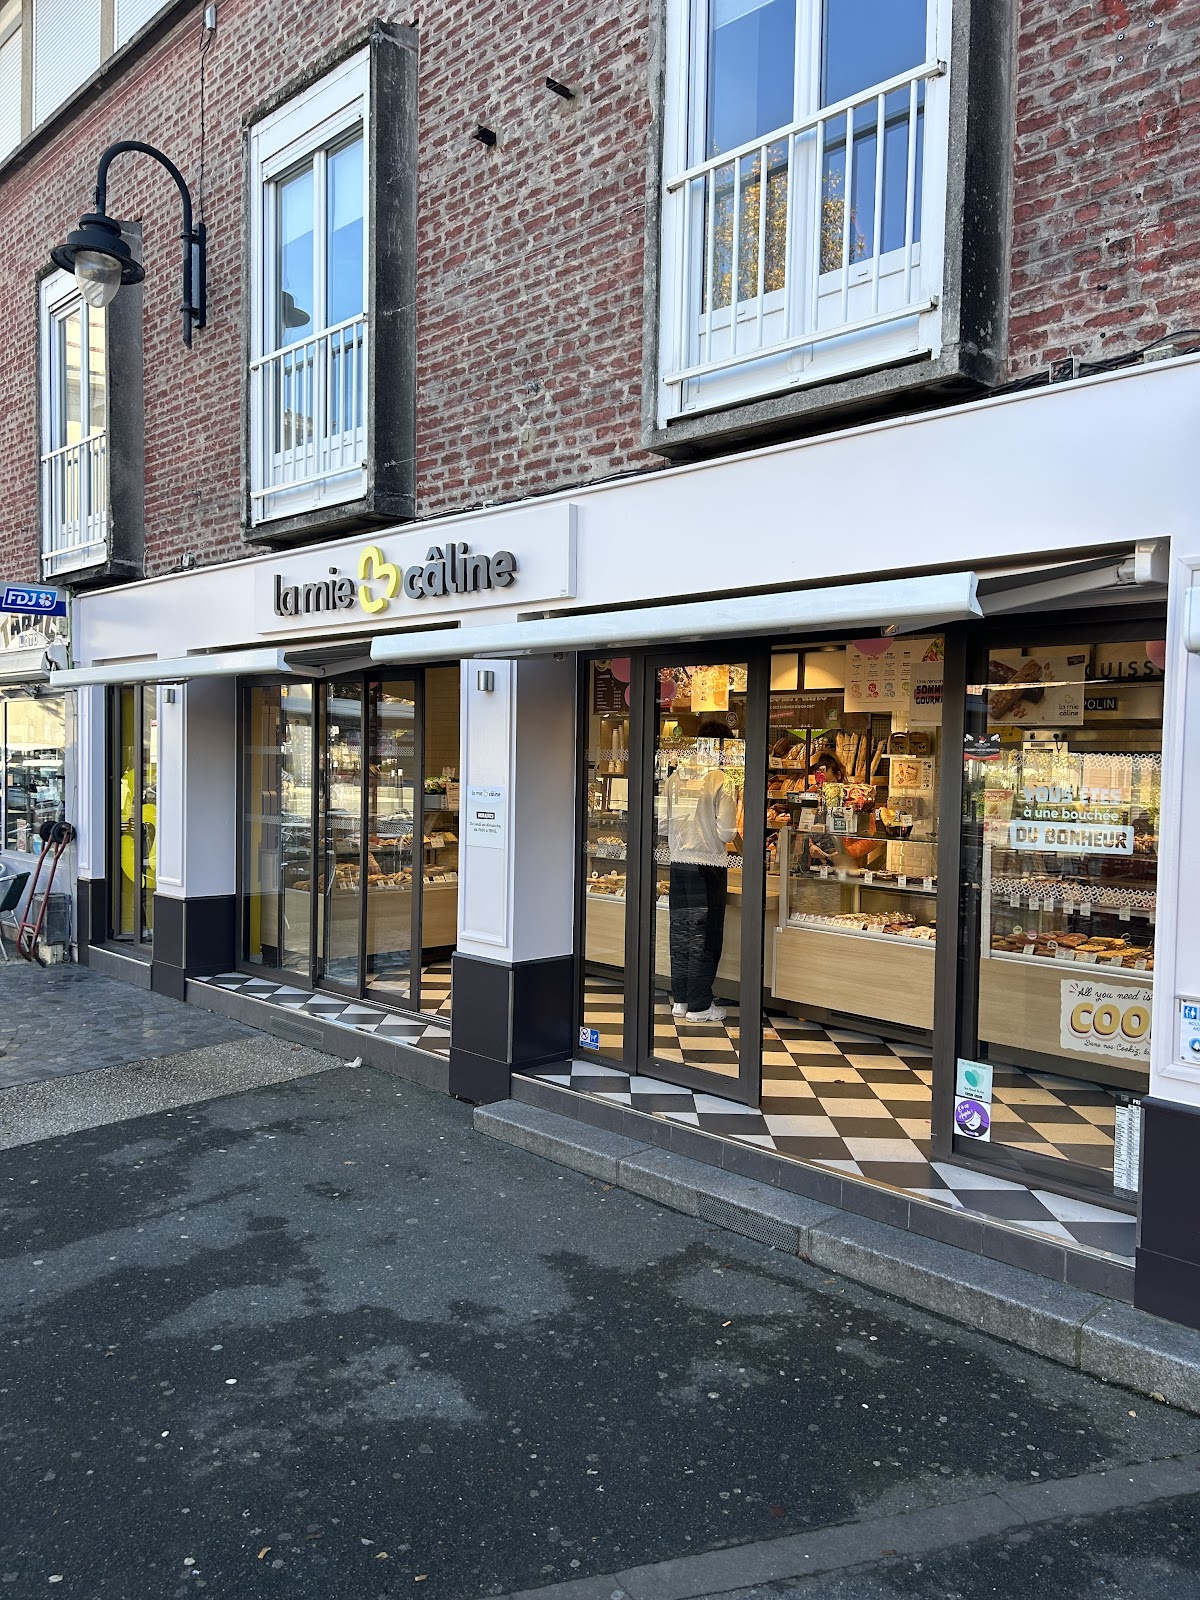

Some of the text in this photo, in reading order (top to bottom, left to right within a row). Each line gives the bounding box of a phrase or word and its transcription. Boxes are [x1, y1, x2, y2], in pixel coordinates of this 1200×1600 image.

[273, 541, 519, 617] la mie câline
[7, 590, 37, 606] FDJ
[18, 632, 39, 649] LOTO
[1023, 785, 1073, 804] VOUS
[1023, 805, 1119, 822] à une bouchée
[1016, 827, 1038, 843] DU
[1044, 828, 1127, 849] BONHEUR
[1077, 986, 1093, 998] All
[1094, 991, 1113, 1002] you
[1116, 989, 1141, 1001] need
[1070, 1002, 1152, 1039] COO
[1084, 1040, 1101, 1048] Dans
